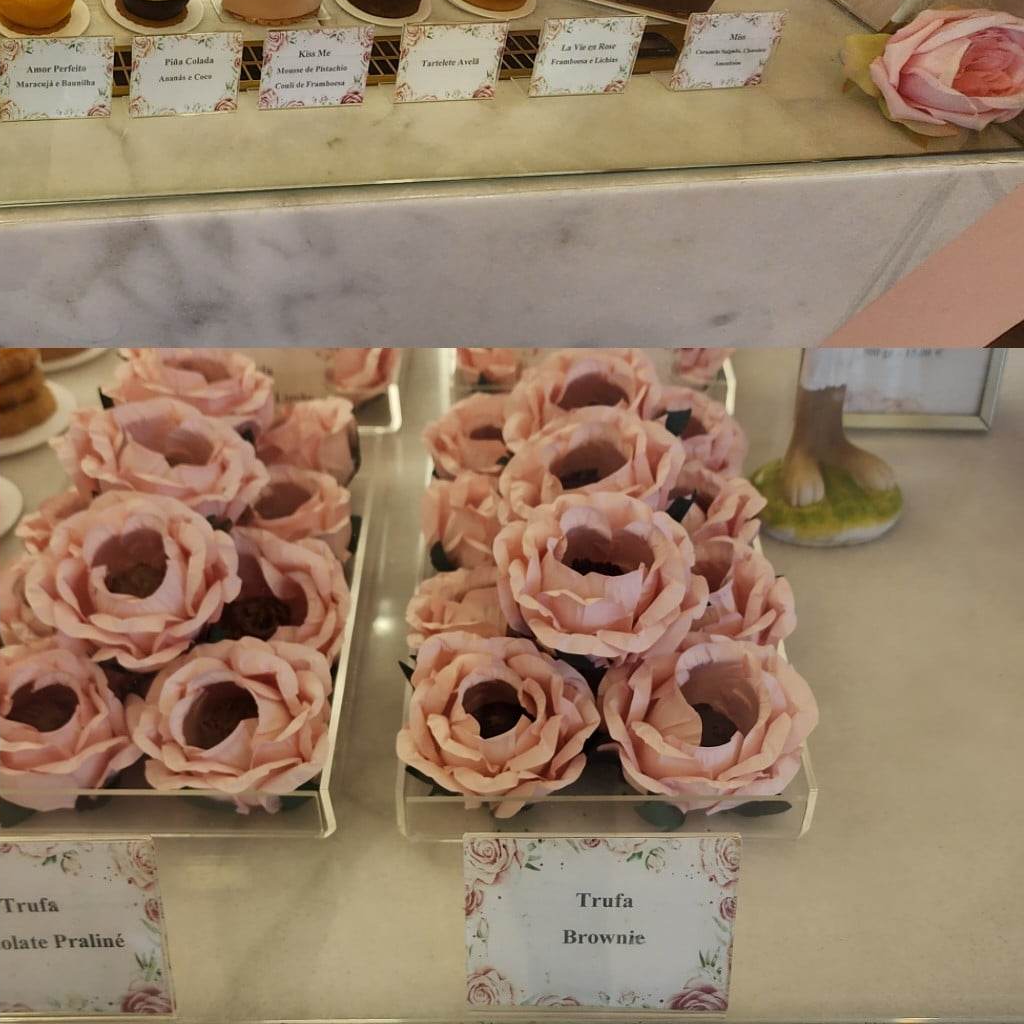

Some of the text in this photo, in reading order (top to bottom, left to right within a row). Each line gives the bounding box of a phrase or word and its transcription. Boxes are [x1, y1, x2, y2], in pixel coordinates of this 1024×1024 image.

[561, 43, 572, 52] La
[574, 43, 587, 51] Vie
[598, 42, 617, 51] Rose
[298, 48, 332, 58] Kiss Me
[165, 56, 215, 66] Piña Colada
[422, 57, 480, 68] Tartelete Avelã
[26, 63, 87, 74] Amor Perfeito
[276, 64, 348, 75] Mousse de Pistachio
[158, 73, 186, 82] Ananás
[194, 72, 213, 81] Coco
[16, 79, 54, 89] Maracujá
[61, 78, 96, 87] Baunilha
[296, 81, 305, 89] de
[305, 79, 345, 88] Framboesa
[0, 897, 60, 913] Trufa
[576, 891, 634, 908] Trufa
[0, 933, 126, 950] olate Praliné
[561, 928, 647, 945] Brownie
